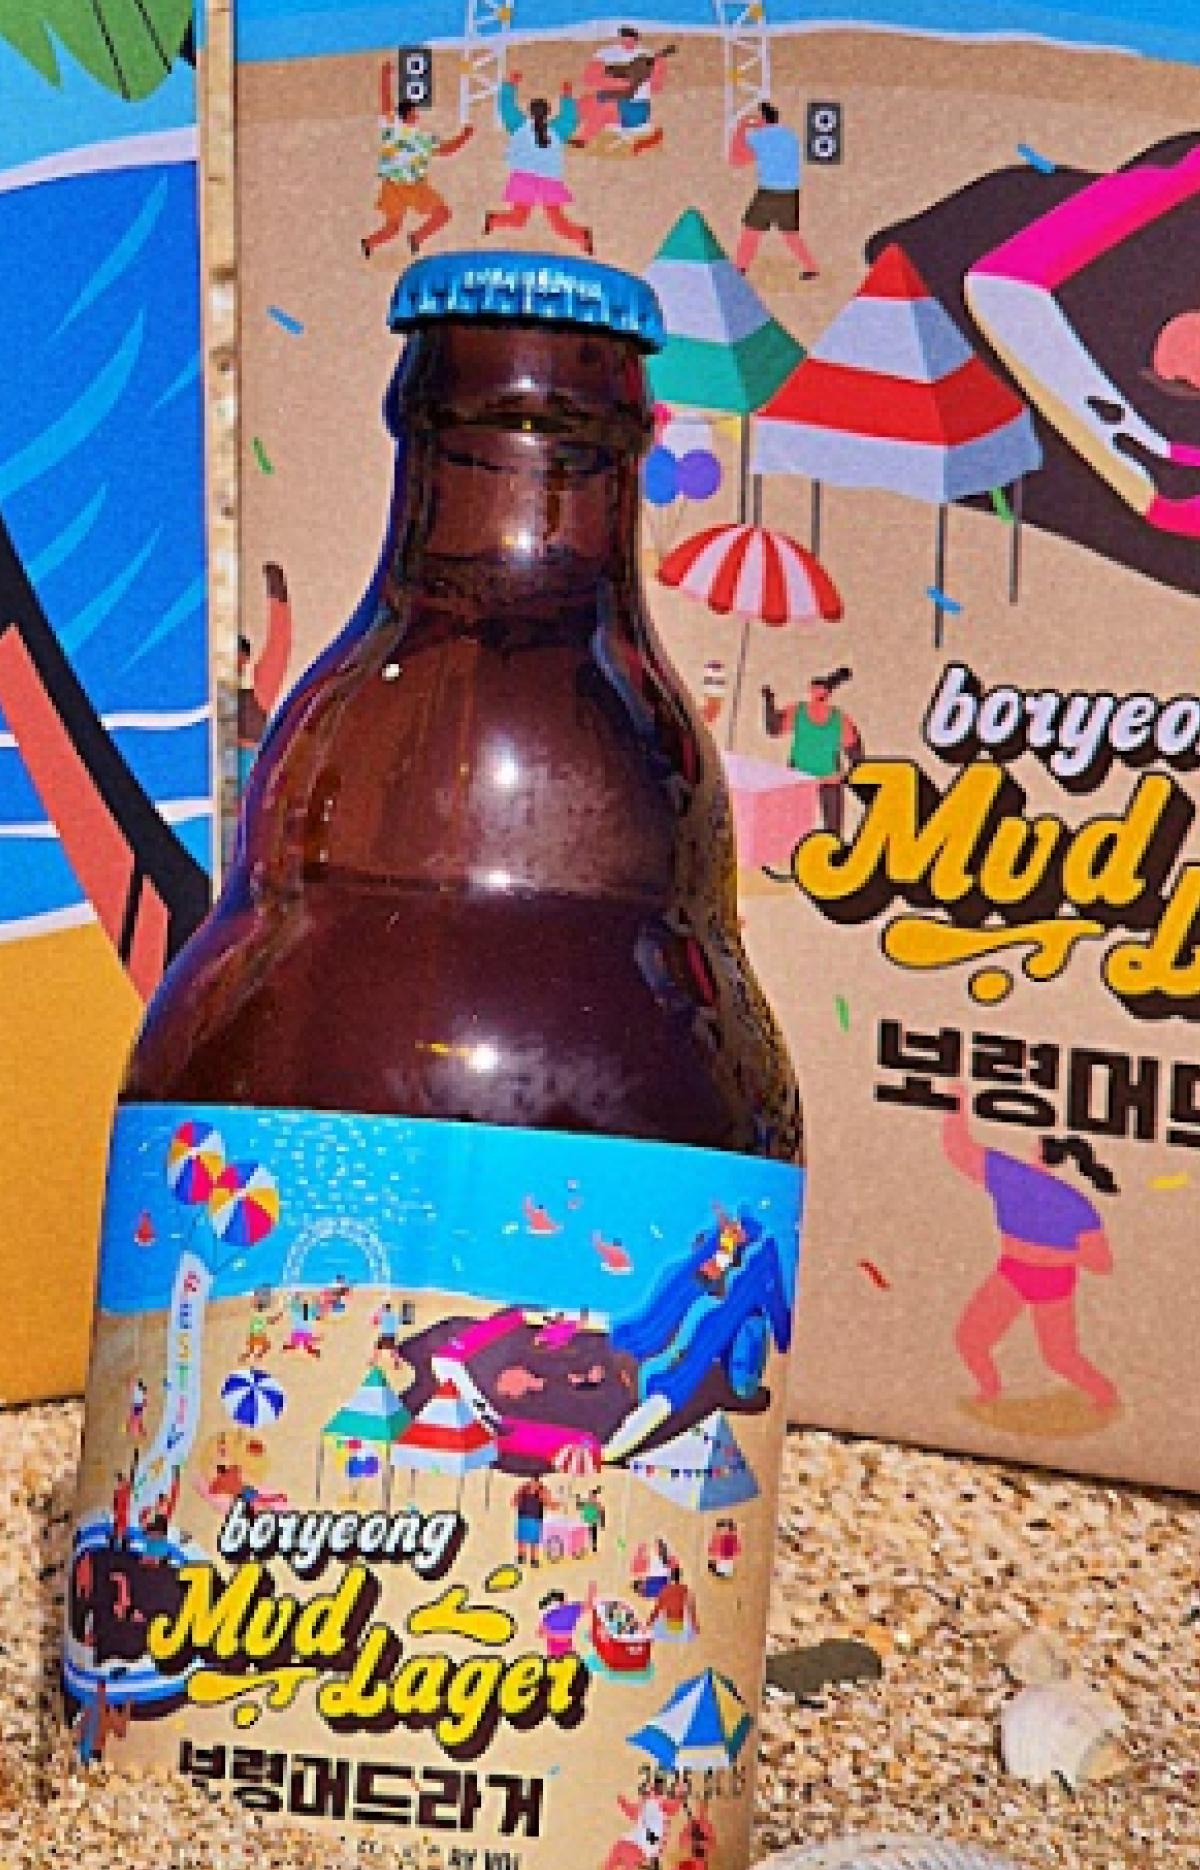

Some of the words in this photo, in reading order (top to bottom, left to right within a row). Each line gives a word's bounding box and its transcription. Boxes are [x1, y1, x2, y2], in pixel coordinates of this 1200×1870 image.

[794, 758, 1188, 922] Mud
[216, 1501, 466, 1580] boryeong
[148, 1560, 372, 1666] Mud
[316, 1624, 589, 1760] Lager
